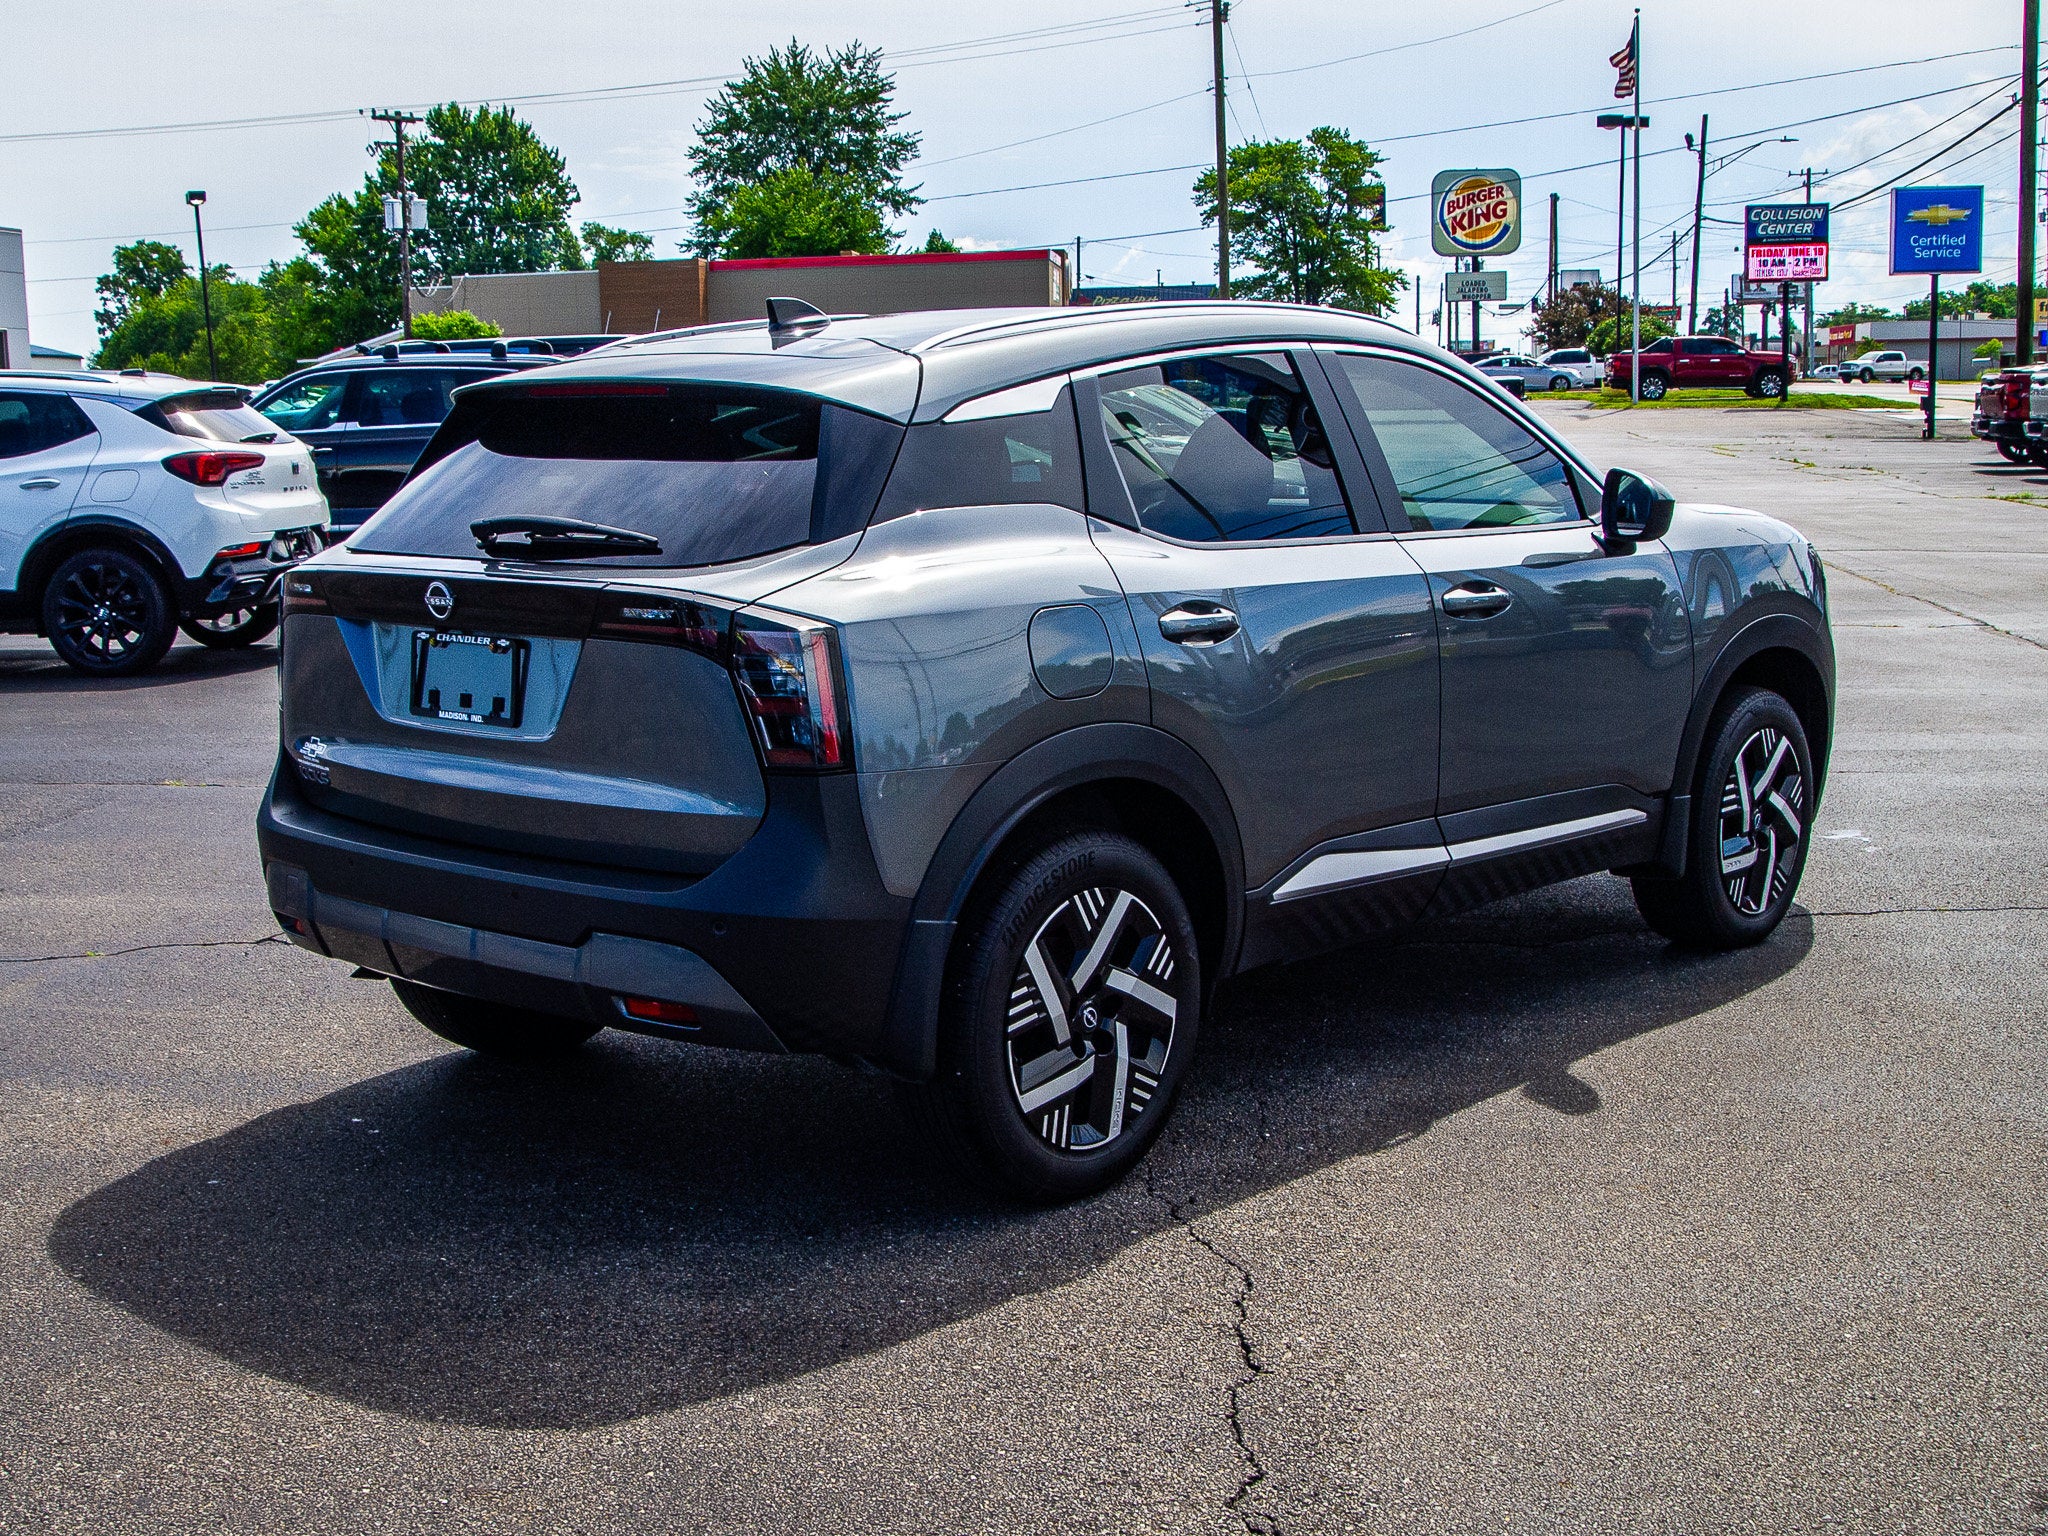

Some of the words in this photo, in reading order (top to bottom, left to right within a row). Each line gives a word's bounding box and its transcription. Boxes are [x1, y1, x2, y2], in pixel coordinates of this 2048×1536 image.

[1447, 185, 1505, 216] BURGER
[1451, 200, 1508, 236] KING
[1751, 208, 1824, 220] COLLISION
[1757, 223, 1813, 235] CENTER
[1910, 234, 1966, 246] Certified
[1788, 247, 1811, 257] JUNE
[1914, 247, 1961, 258] Service
[1758, 259, 1769, 268] 10
[1771, 258, 1787, 267] AM
[1794, 258, 1801, 267] 2
[1803, 257, 1818, 267] PM
[1093, 295, 1129, 306] Pizza
[436, 633, 491, 645] CHANDLER
[470, 714, 484, 723] IND.
[1003, 851, 1097, 948] BRIDGESTONE
